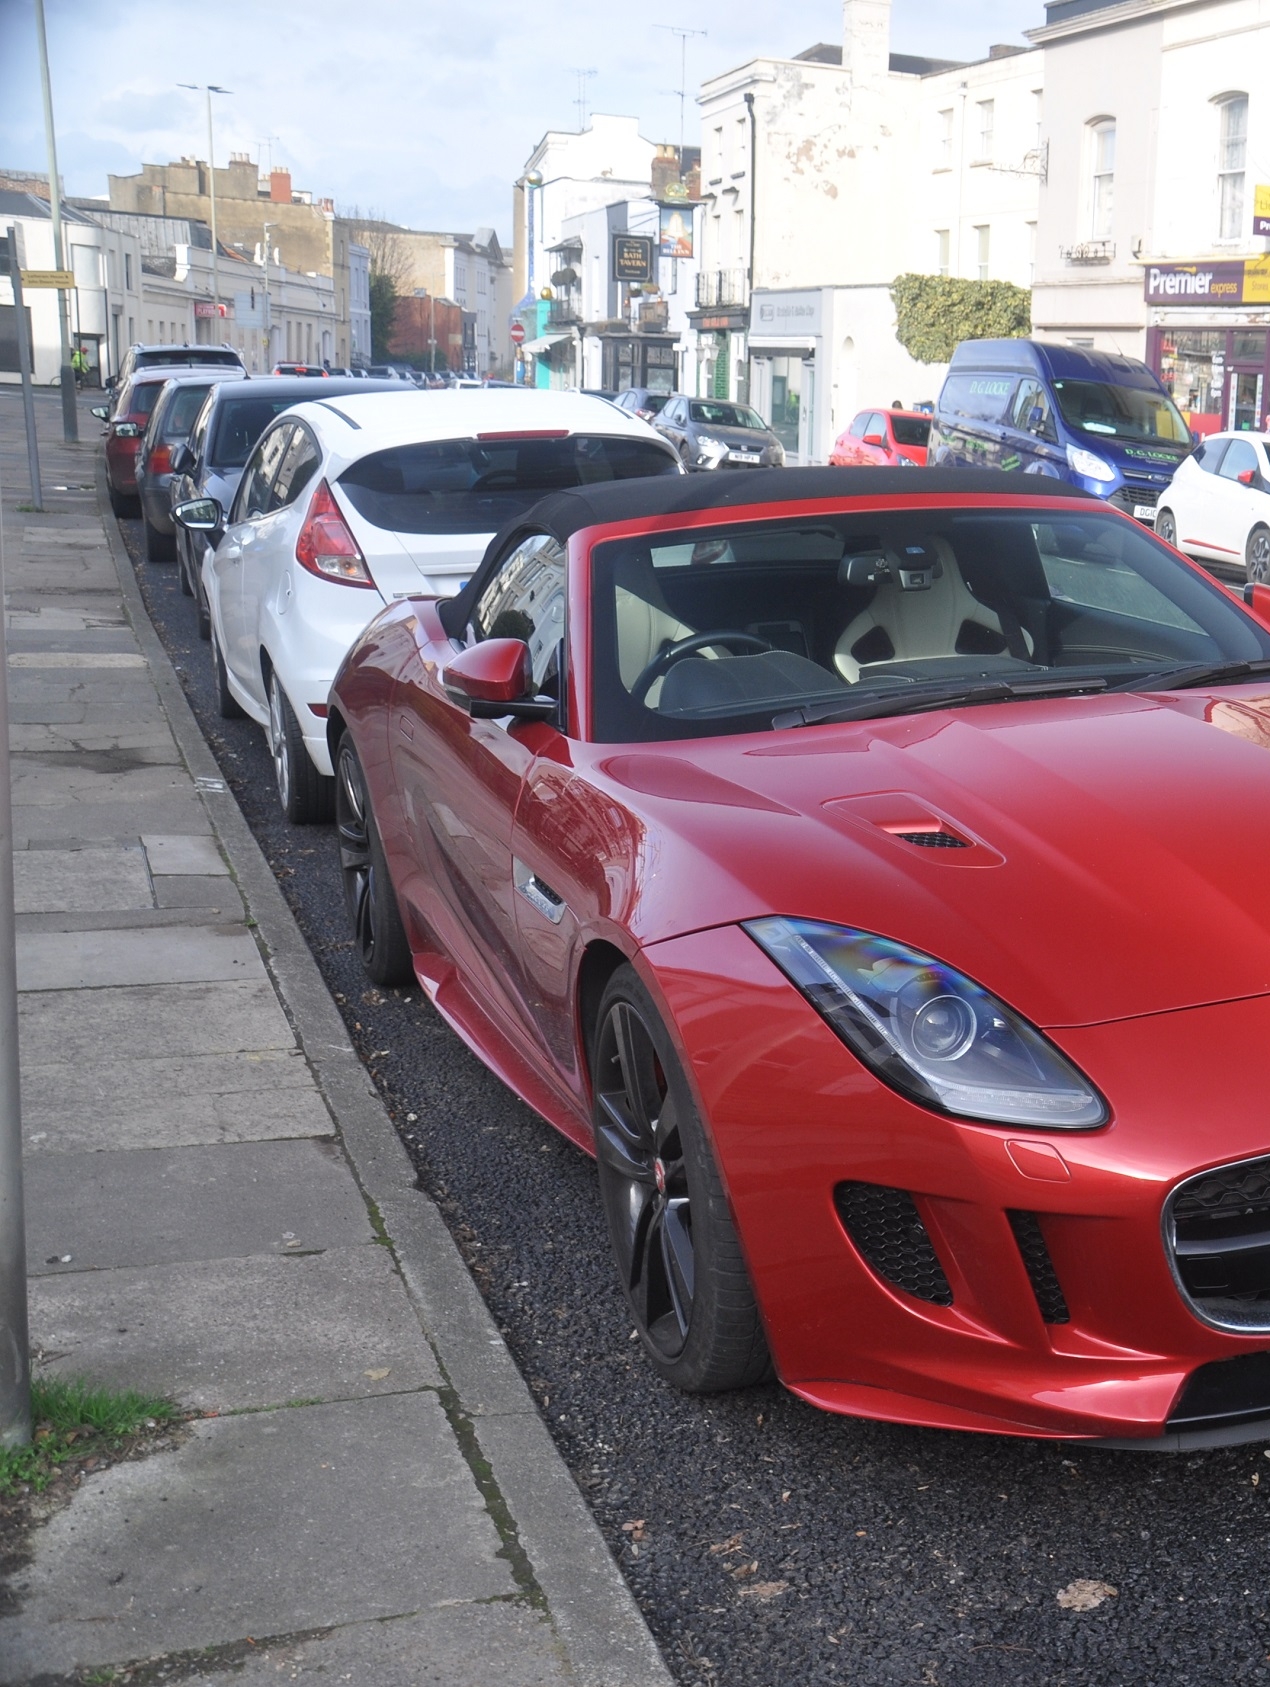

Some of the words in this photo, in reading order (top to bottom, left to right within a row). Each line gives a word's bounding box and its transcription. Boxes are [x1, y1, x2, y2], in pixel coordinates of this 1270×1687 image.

[623, 252, 642, 260] BATH
[619, 259, 647, 267] TAVERN
[1149, 267, 1213, 295] Premier
[1211, 281, 1238, 298] express
